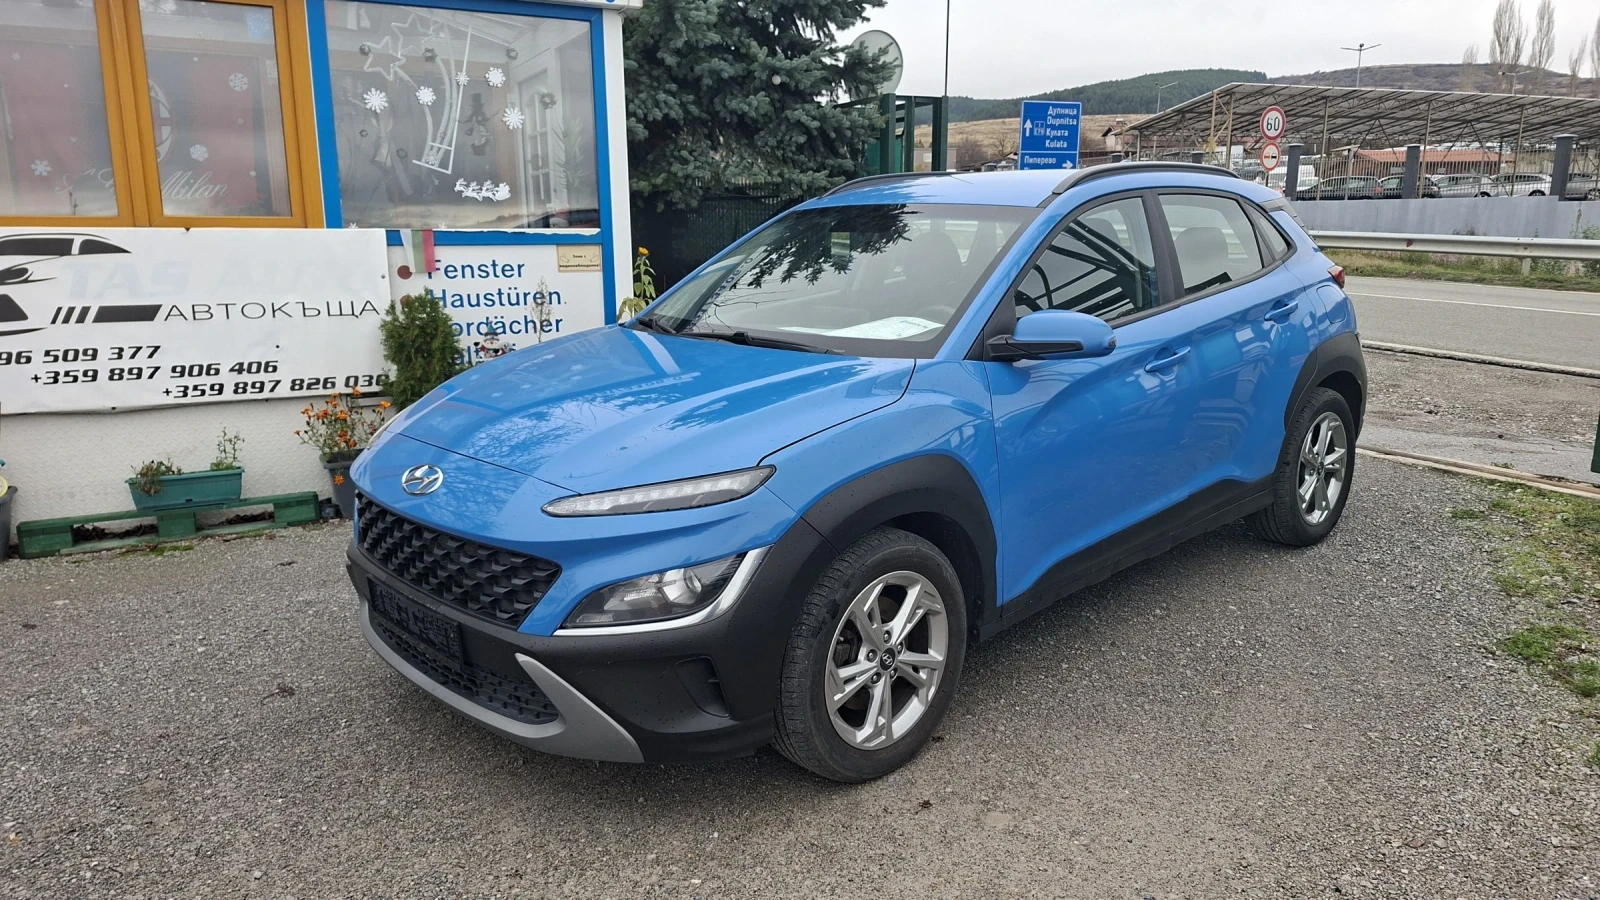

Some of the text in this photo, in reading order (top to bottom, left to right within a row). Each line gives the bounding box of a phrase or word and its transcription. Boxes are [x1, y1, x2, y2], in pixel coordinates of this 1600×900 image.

[1047, 106, 1077, 116] Дупница
[1047, 117, 1077, 126] Dupnitsa
[1266, 117, 1280, 131] 60
[1046, 128, 1068, 138] Кулата
[1045, 139, 1067, 148] Kulata
[1024, 156, 1056, 165] Пиперево
[163, 300, 381, 321] АВТОКЪЩА
[449, 315, 563, 337] ordächer
[42, 347, 99, 363] 509
[107, 345, 162, 361] 377
[31, 360, 279, 385] +359 897 906 406
[162, 383, 225, 399] +359
[232, 379, 282, 395] 897
[289, 376, 337, 392] 826
